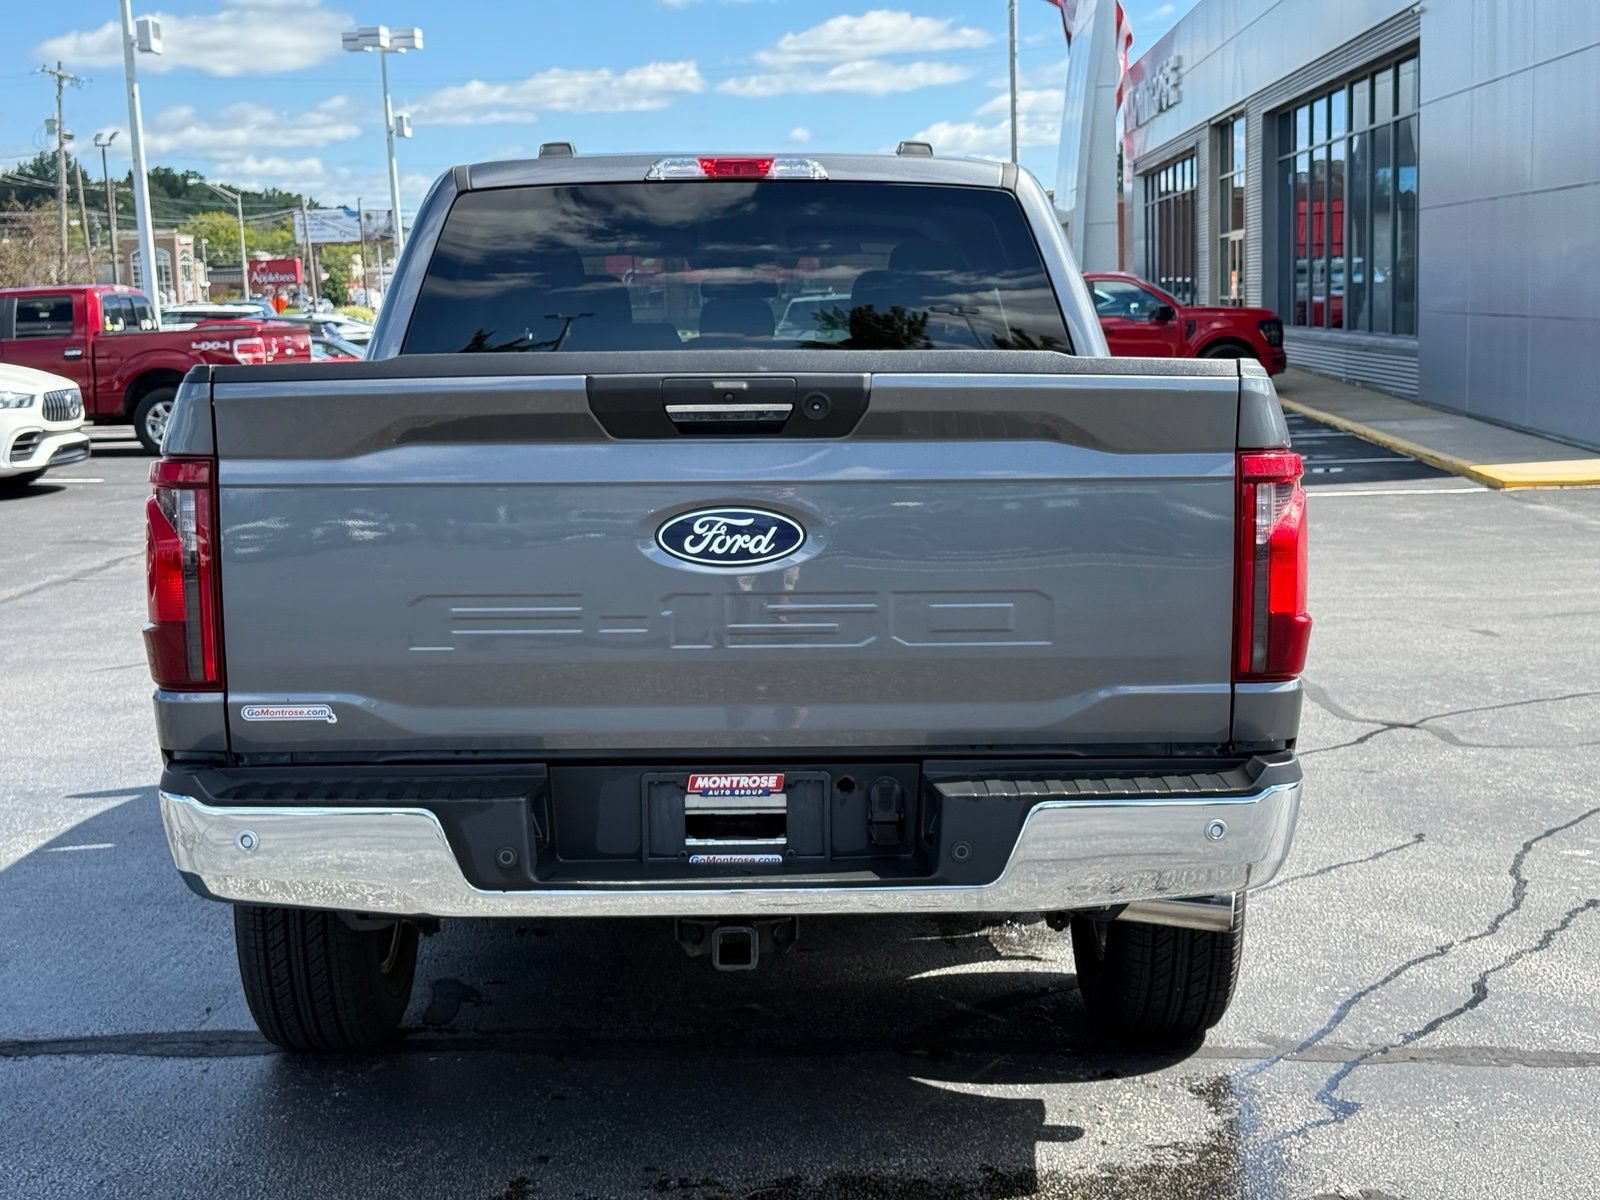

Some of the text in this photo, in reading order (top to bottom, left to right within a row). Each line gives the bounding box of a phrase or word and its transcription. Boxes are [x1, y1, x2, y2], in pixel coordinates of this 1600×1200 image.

[684, 516, 778, 554] Ford
[406, 591, 1053, 650] F-150
[247, 709, 327, 717] GoMontrose.com
[694, 775, 778, 788] MONTROSE
[691, 856, 780, 864] GoMontrosecom
